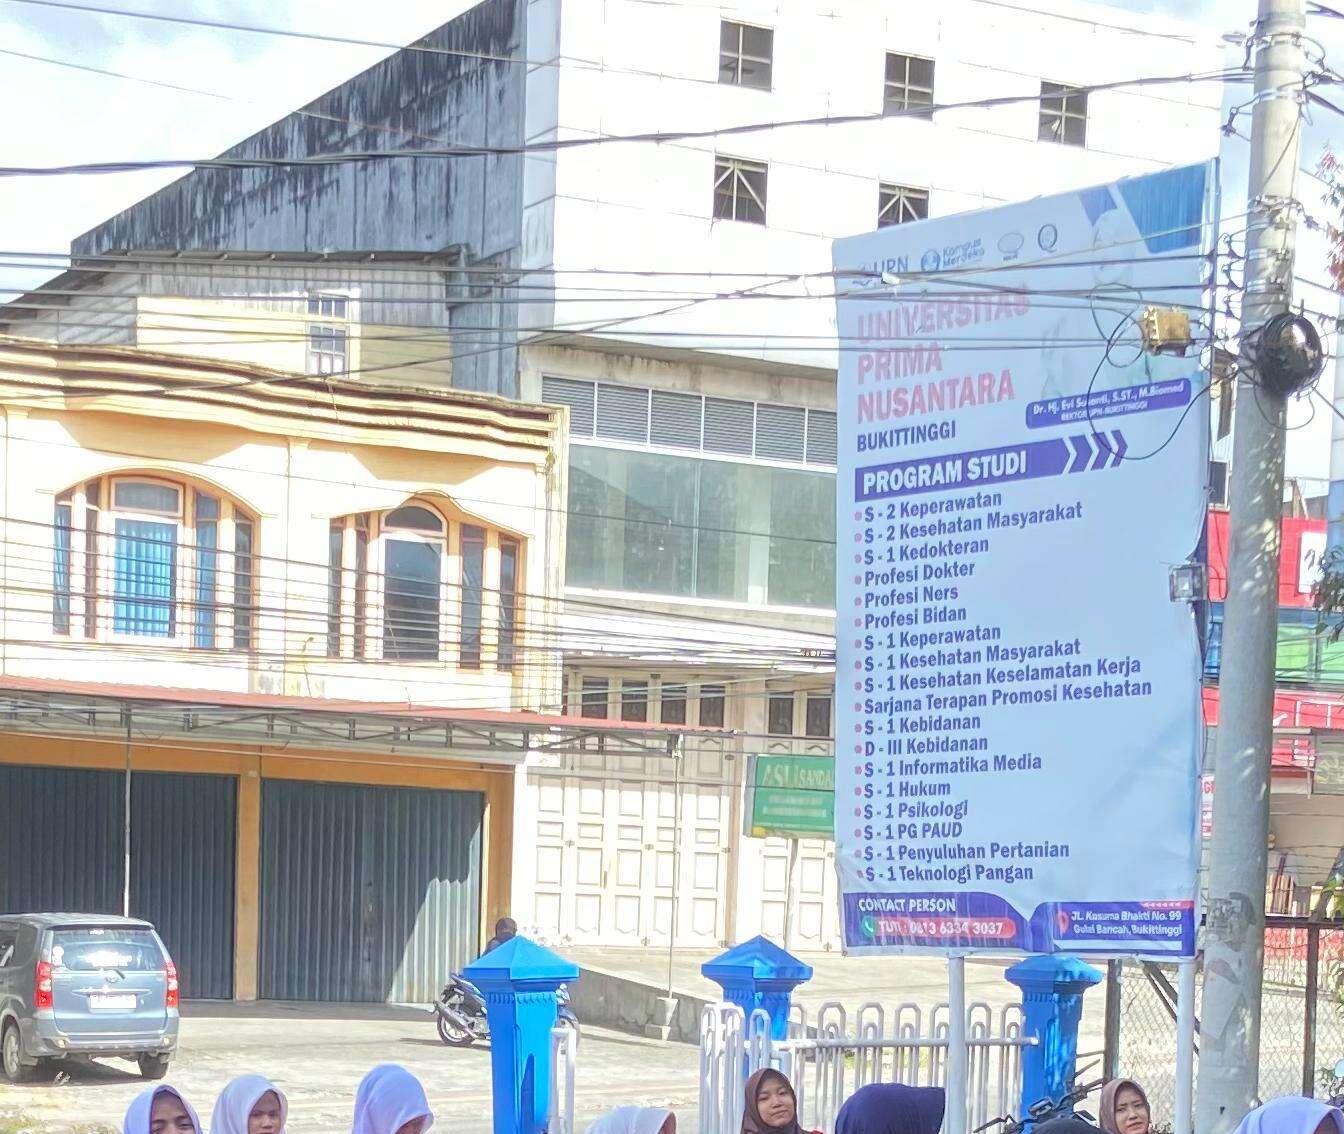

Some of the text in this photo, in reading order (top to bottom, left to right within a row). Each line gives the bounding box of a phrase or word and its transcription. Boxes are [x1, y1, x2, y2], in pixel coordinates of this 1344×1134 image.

[858, 285, 1030, 344] UNIVERSITAS
[858, 342, 943, 384] PRIMA
[858, 369, 1015, 424] NUSANTARA
[857, 420, 956, 452] BUKITTINGGI
[863, 450, 1027, 495] PROGRAM STUDI
[864, 507, 875, 522] S
[886, 504, 895, 519] 2
[900, 492, 1002, 520] Keperawatan
[864, 528, 874, 544] S
[886, 525, 895, 541] 2
[900, 517, 982, 540] Kesehatan
[987, 502, 1083, 530] Masyarakat
[864, 549, 874, 565] S
[886, 547, 895, 563] 1
[899, 538, 989, 561] Kedokteran
[865, 561, 975, 587] Profesi Dokter
[865, 585, 959, 609] Profesi Ners
[865, 606, 967, 630] Profesi Bidan
[864, 635, 874, 650] S
[886, 633, 895, 648] 1
[900, 625, 1001, 650] Keperawatan
[864, 656, 874, 671] S
[886, 654, 895, 670] 1
[900, 648, 981, 670] Kesehatan
[986, 638, 1081, 663] Masyarakat
[864, 677, 874, 693] S
[886, 676, 895, 691] 1
[900, 669, 981, 690] Kesehatan
[986, 661, 1091, 685] Keselamatan
[1097, 656, 1141, 677] Kerja
[864, 680, 1152, 716] Sarjana Terapan Promosi Kesehatan
[864, 720, 874, 735] S
[887, 718, 896, 734] 1
[900, 715, 981, 733] Kebidanan
[865, 741, 875, 757] D
[887, 739, 902, 755] III
[907, 736, 988, 754] Kebidanan
[864, 762, 874, 778] S
[886, 760, 896, 776] 1
[899, 756, 988, 776] Informatika
[993, 753, 1042, 771] Media
[864, 783, 874, 799] S
[886, 781, 895, 797] 1
[899, 780, 951, 797] Hukum
[863, 804, 874, 820] S
[885, 802, 894, 818] 1
[898, 799, 968, 820] Psikologi
[863, 824, 873, 840] S
[885, 823, 895, 839] 1
[898, 822, 918, 839] PG
[922, 821, 963, 839] PAUD
[864, 845, 874, 862] S
[886, 845, 895, 860] 1
[899, 843, 986, 863] Penyuluhan
[990, 840, 1070, 858] Pertanian
[865, 866, 875, 882] S
[887, 865, 897, 881] 1
[899, 864, 971, 884] Teknologi
[975, 864, 1034, 883] Pangan
[858, 898, 957, 912] CONTACT PERSON
[1151, 911, 1168, 921] No.
[1169, 911, 1182, 921] 99
[972, 921, 1003, 935] 3037
[1131, 924, 1183, 937] Bukittinggi
